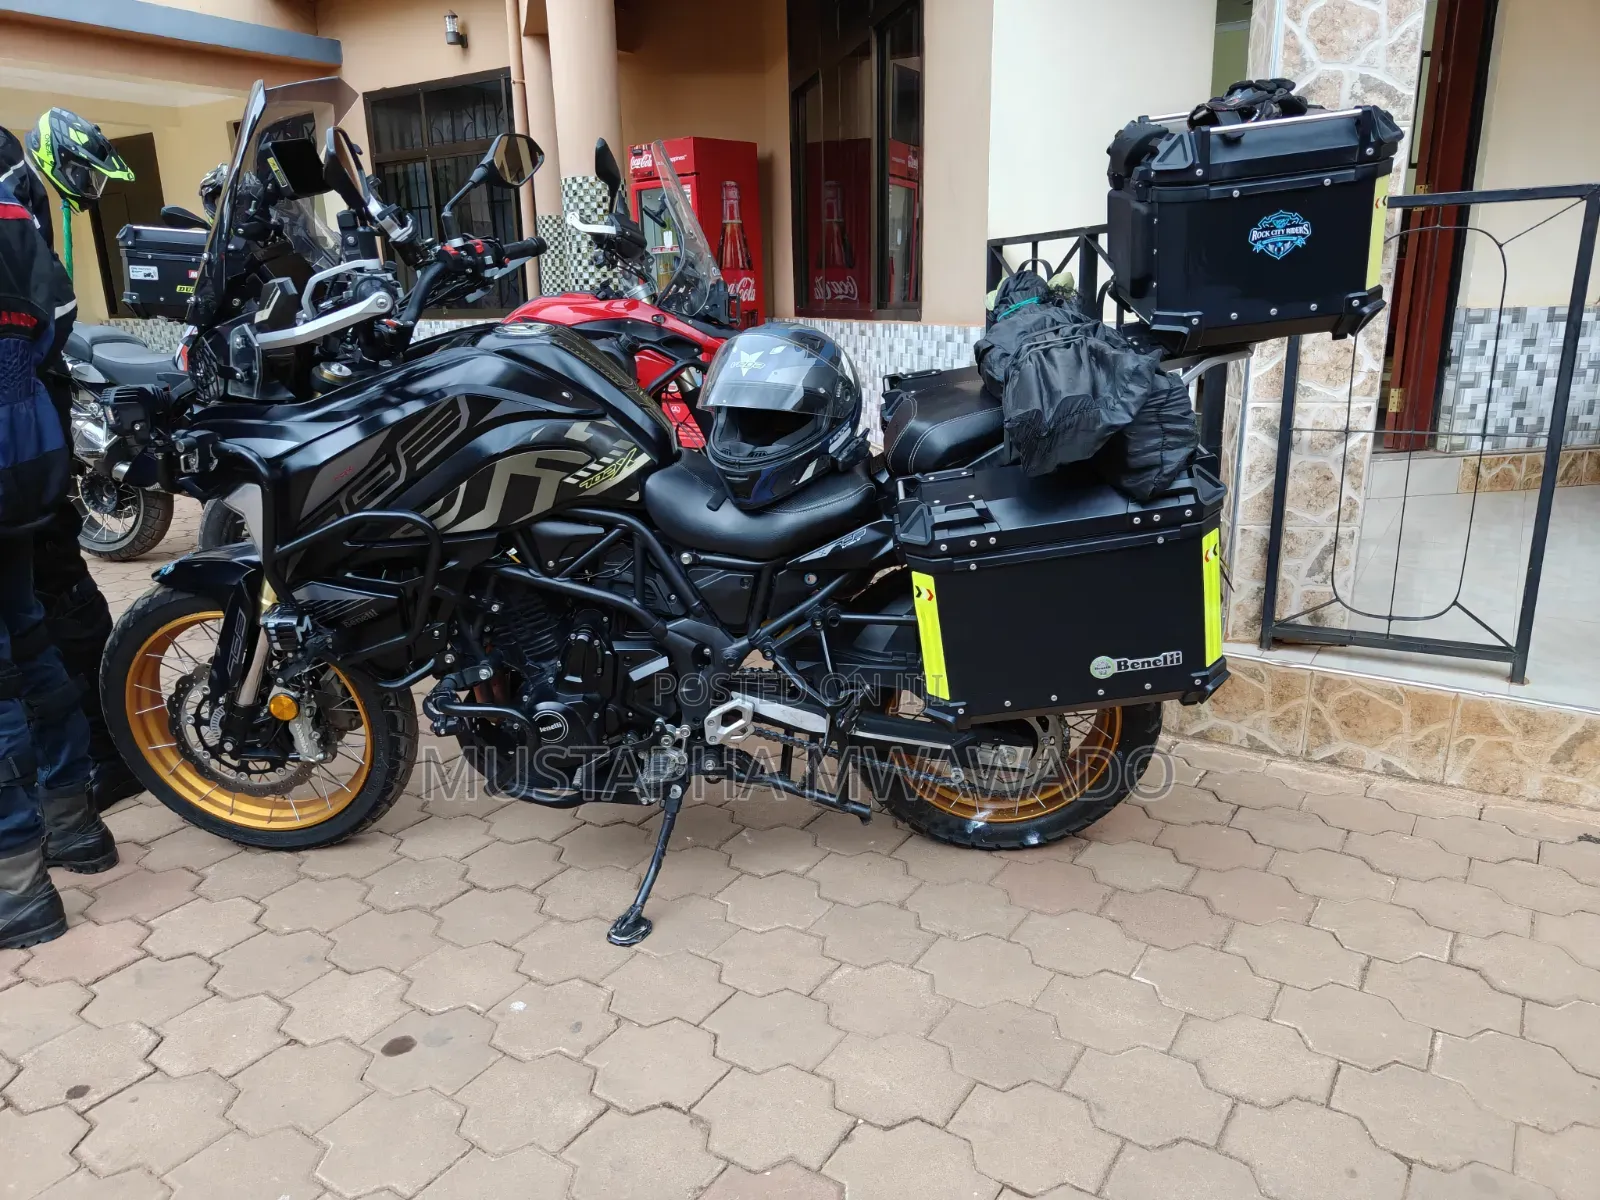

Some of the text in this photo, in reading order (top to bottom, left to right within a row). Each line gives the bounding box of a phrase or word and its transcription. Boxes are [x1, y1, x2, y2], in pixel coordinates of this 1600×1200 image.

[1251, 230, 1270, 241] ROCK
[1286, 224, 1309, 235] RIDERS
[1117, 652, 1181, 671] Benelli
